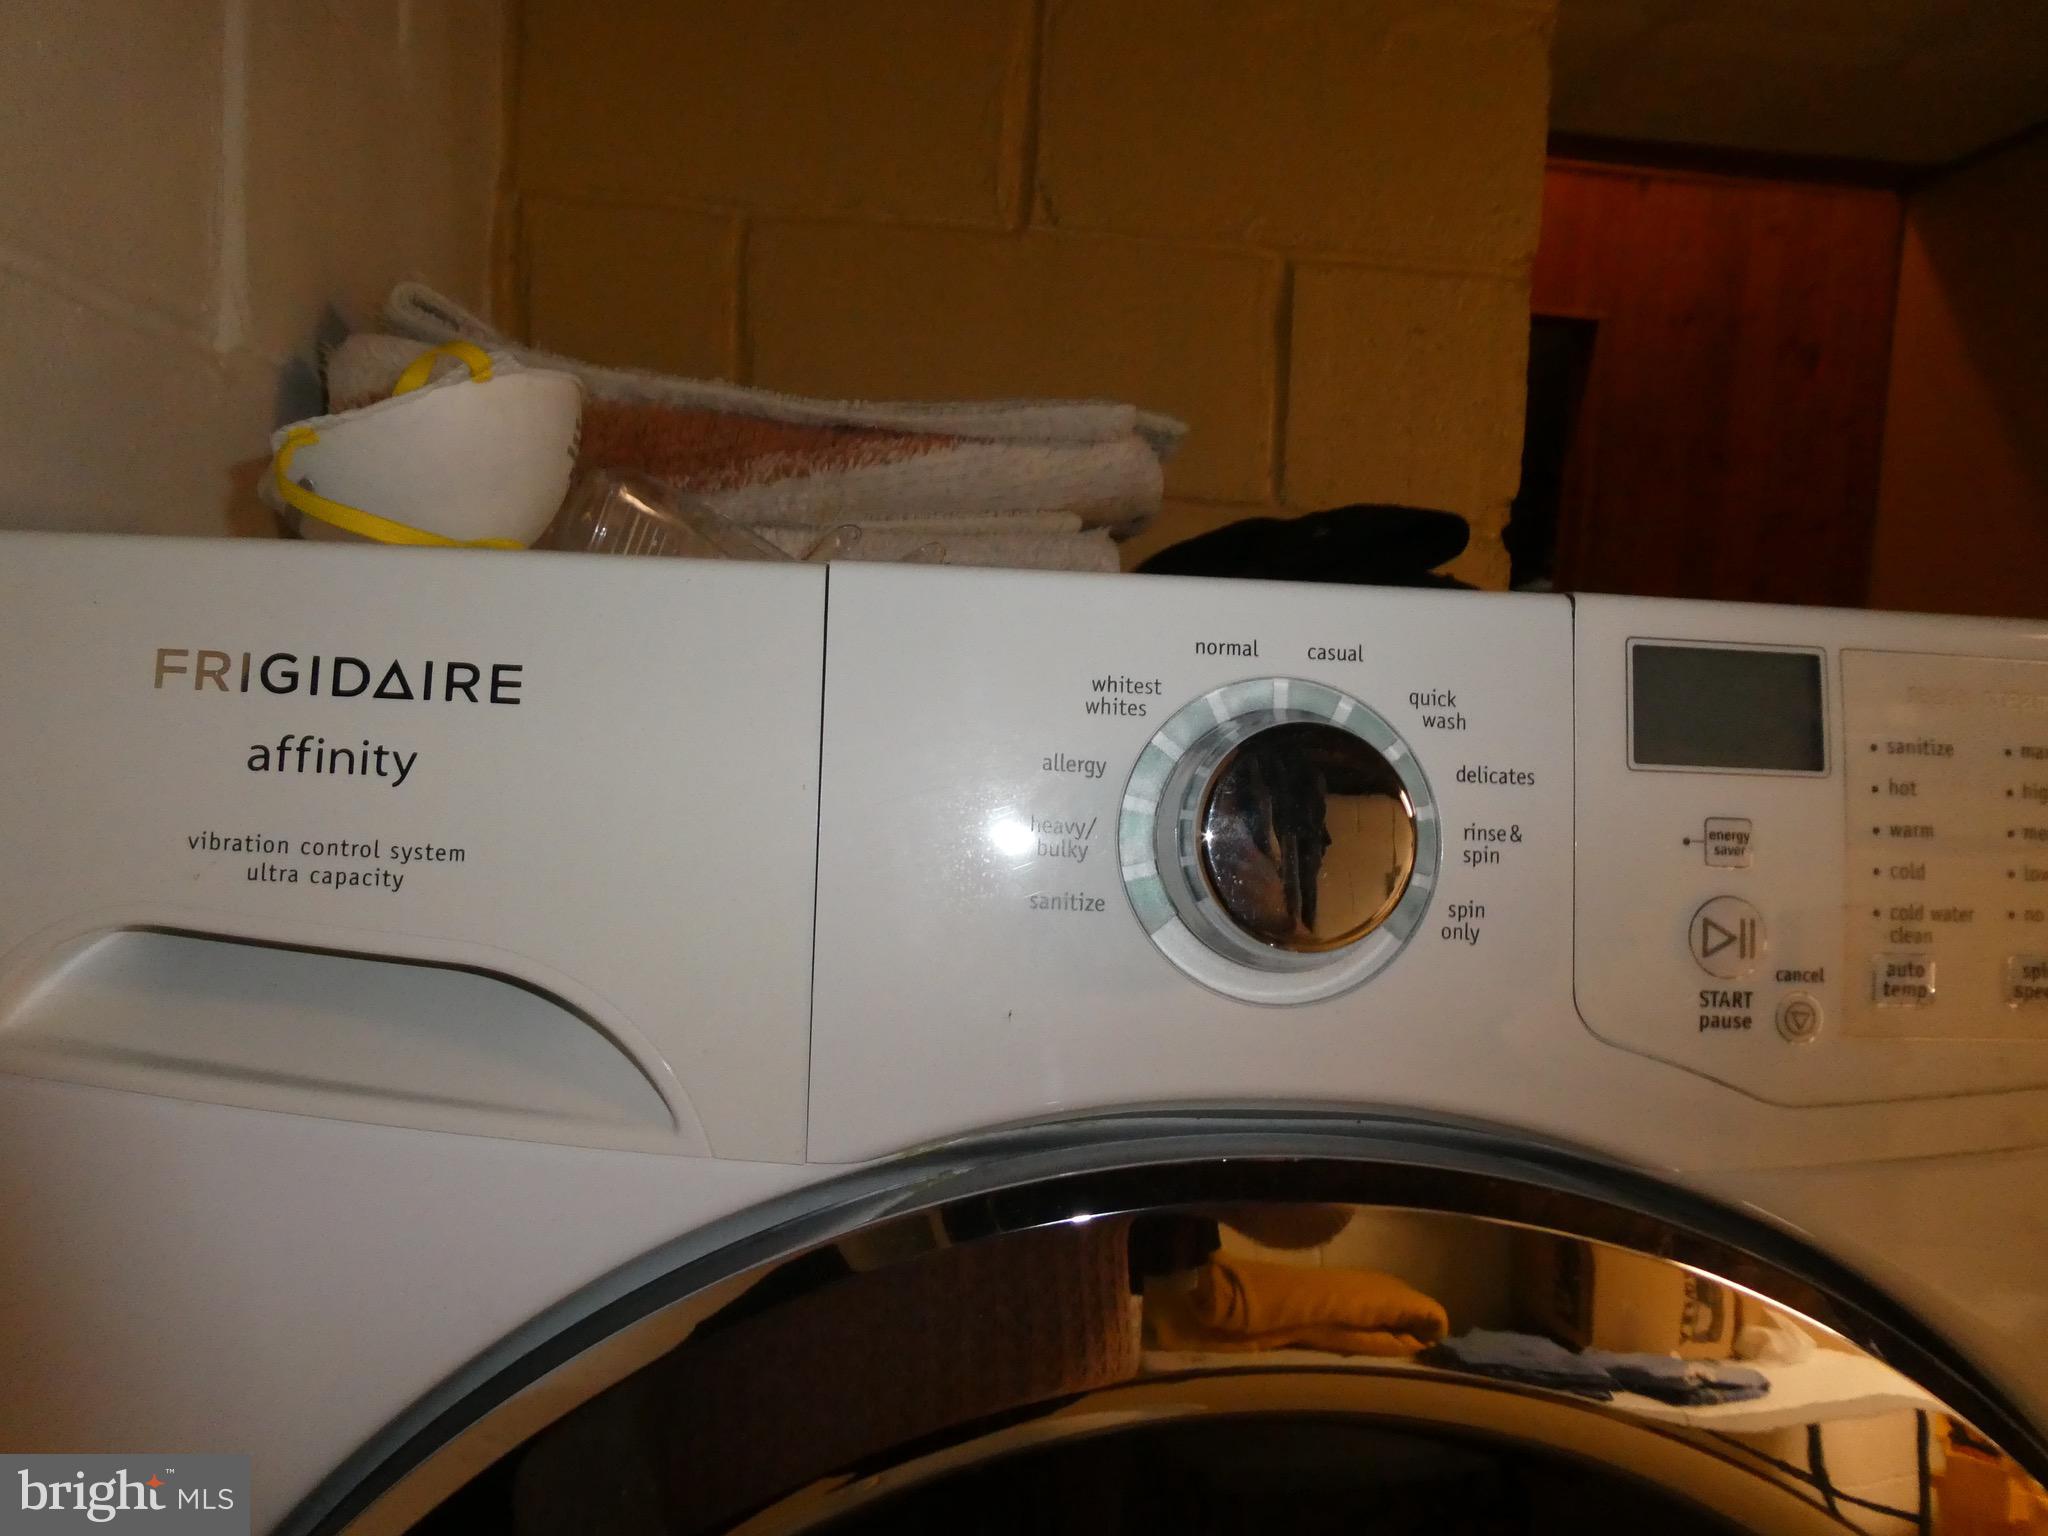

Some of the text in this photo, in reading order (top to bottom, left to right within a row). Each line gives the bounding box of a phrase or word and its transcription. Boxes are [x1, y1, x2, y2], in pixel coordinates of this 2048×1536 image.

[1194, 639, 1259, 657] normal
[1306, 643, 1364, 663] casual
[153, 648, 524, 705] FRIGIDAIRE
[1091, 675, 1162, 696] whitest
[1084, 695, 1148, 718] whites
[1408, 688, 1457, 709] quick
[1422, 709, 1467, 731] wash
[1886, 738, 1954, 758] sanitize
[246, 734, 418, 788] affinity
[1042, 752, 1107, 779] allergy
[1456, 764, 1536, 786] delicates
[1888, 779, 1918, 797] hot
[2022, 783, 2048, 807] hig
[1030, 814, 1098, 841] heavy/
[1708, 828, 1751, 846] energy
[1889, 823, 1935, 839] warm
[188, 831, 466, 865] vibration control system
[1037, 838, 1089, 864] bulky
[1463, 845, 1500, 868] spin
[1713, 842, 1746, 857] saver
[246, 865, 404, 893] ultra capacity
[1889, 863, 1926, 881] cold
[1029, 891, 1106, 912] sanitize
[1448, 903, 1486, 926] spin
[1889, 903, 1974, 924] cold water
[1441, 923, 1481, 945] only
[1889, 925, 1933, 944] clean
[1775, 966, 1826, 984] cancel
[1886, 961, 1926, 979] auto
[1700, 990, 1753, 1010] START
[1883, 980, 1928, 1002] temp
[2013, 984, 2048, 1003] spee
[1699, 1012, 1753, 1033] pause
